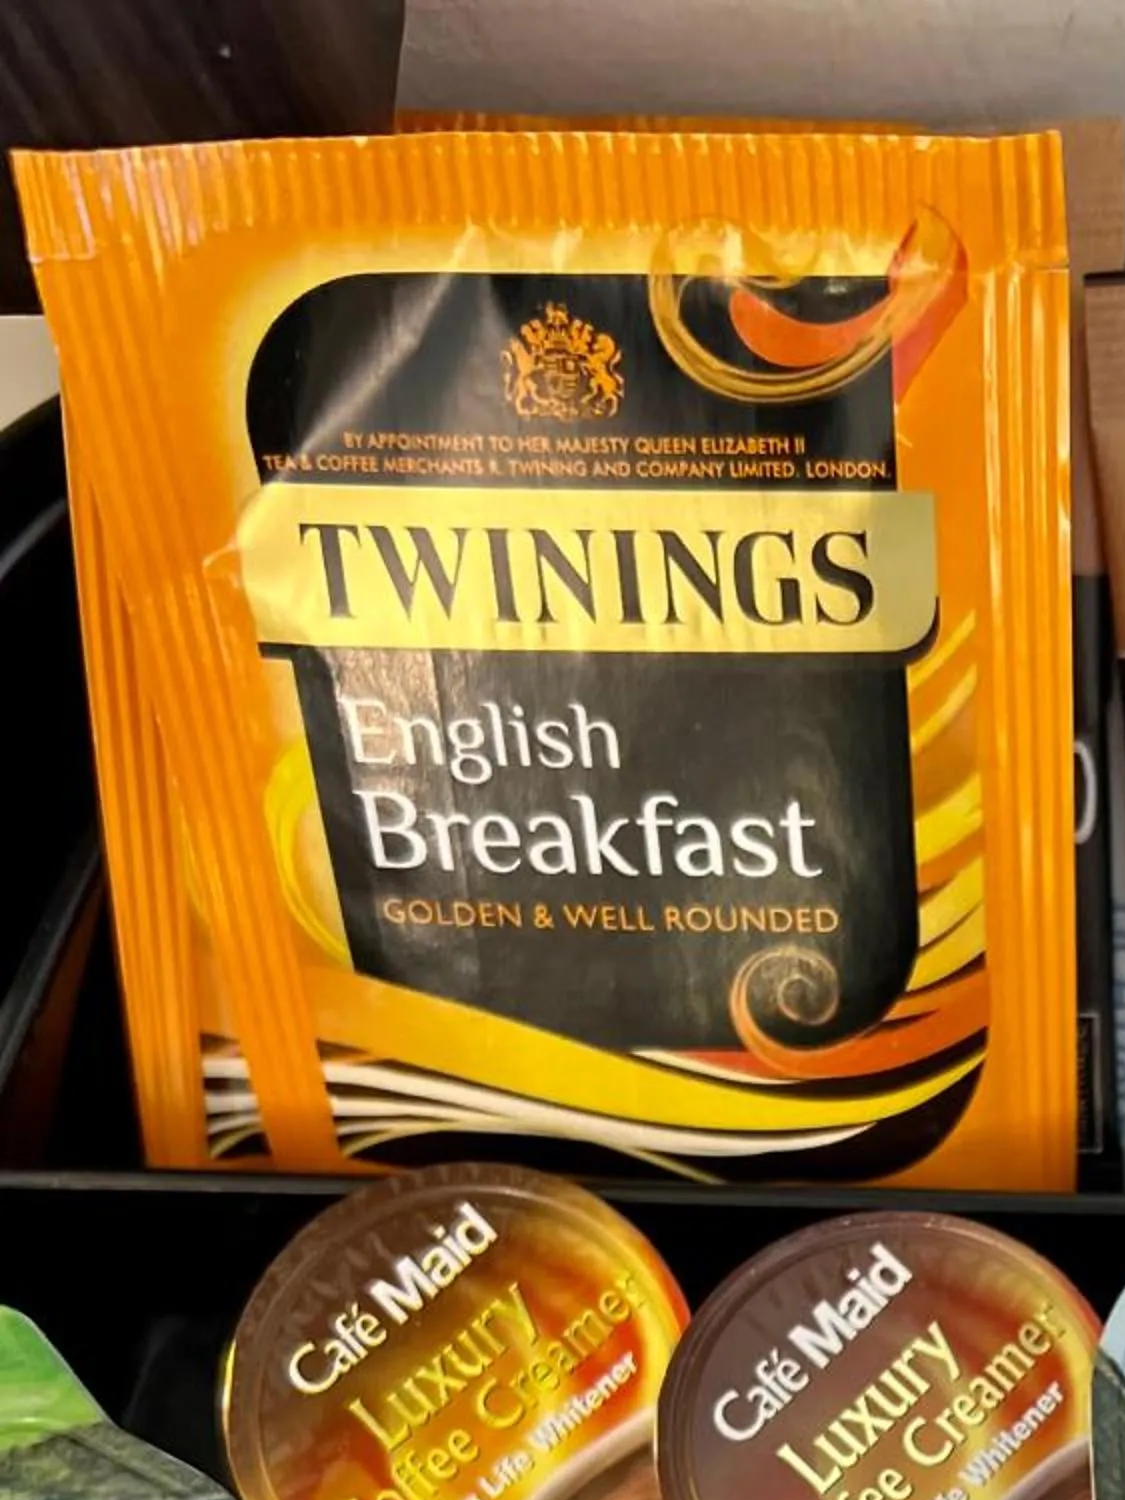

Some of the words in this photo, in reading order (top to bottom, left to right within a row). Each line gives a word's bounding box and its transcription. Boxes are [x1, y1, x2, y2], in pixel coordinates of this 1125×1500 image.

[263, 454, 296, 471] TEA
[316, 455, 378, 473] COFFEE
[383, 457, 484, 475] MERCHANTS
[508, 460, 586, 477] TWINING
[591, 461, 630, 477] AND
[635, 461, 725, 478] COMPANY
[343, 432, 363, 448] BY
[367, 432, 485, 451] APPOINTMENT
[489, 435, 513, 452] TO
[518, 436, 549, 453] HER
[556, 435, 629, 454] MAJESTY
[635, 436, 696, 454] QUEEN
[703, 437, 789, 455] ELIZABETH
[794, 437, 805, 454] II
[300, 523, 875, 628] TWININGS
[338, 696, 622, 785] English
[352, 789, 823, 880] Breakfast
[383, 899, 523, 929] GOLDEN
[534, 905, 555, 930] &
[563, 904, 655, 932] WELL
[664, 906, 839, 934] ROUNDED
[288, 1301, 388, 1395] Café
[370, 1202, 499, 1327] Maid
[475, 1272, 644, 1431] Creamer
[713, 1347, 811, 1443] Café
[788, 1240, 914, 1371] Maid
[348, 1282, 541, 1453] Luxury
[478, 1449, 537, 1500] Life
[527, 1350, 641, 1454] Whitener
[776, 1320, 962, 1496] Luxury
[902, 1298, 1067, 1470] Creamer
[959, 1379, 1066, 1489] Whitener
